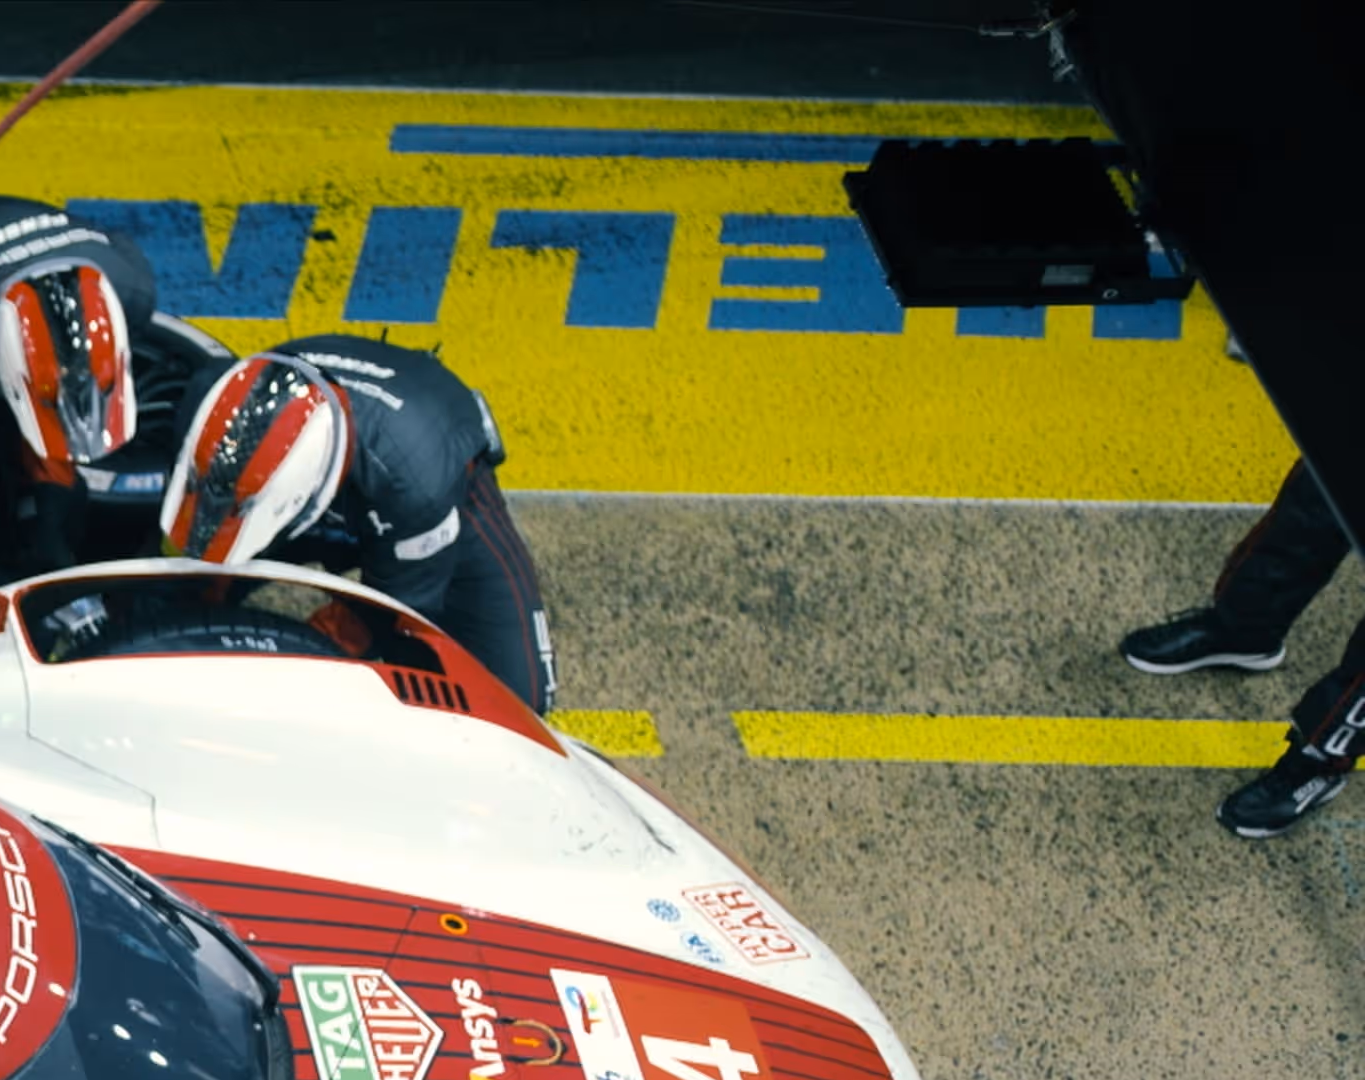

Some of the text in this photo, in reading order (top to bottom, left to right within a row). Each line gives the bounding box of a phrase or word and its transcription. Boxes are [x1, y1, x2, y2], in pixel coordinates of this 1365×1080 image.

[695, 892, 769, 958] HYPER
[717, 890, 796, 953] CAR
[315, 980, 366, 1071] TAG
